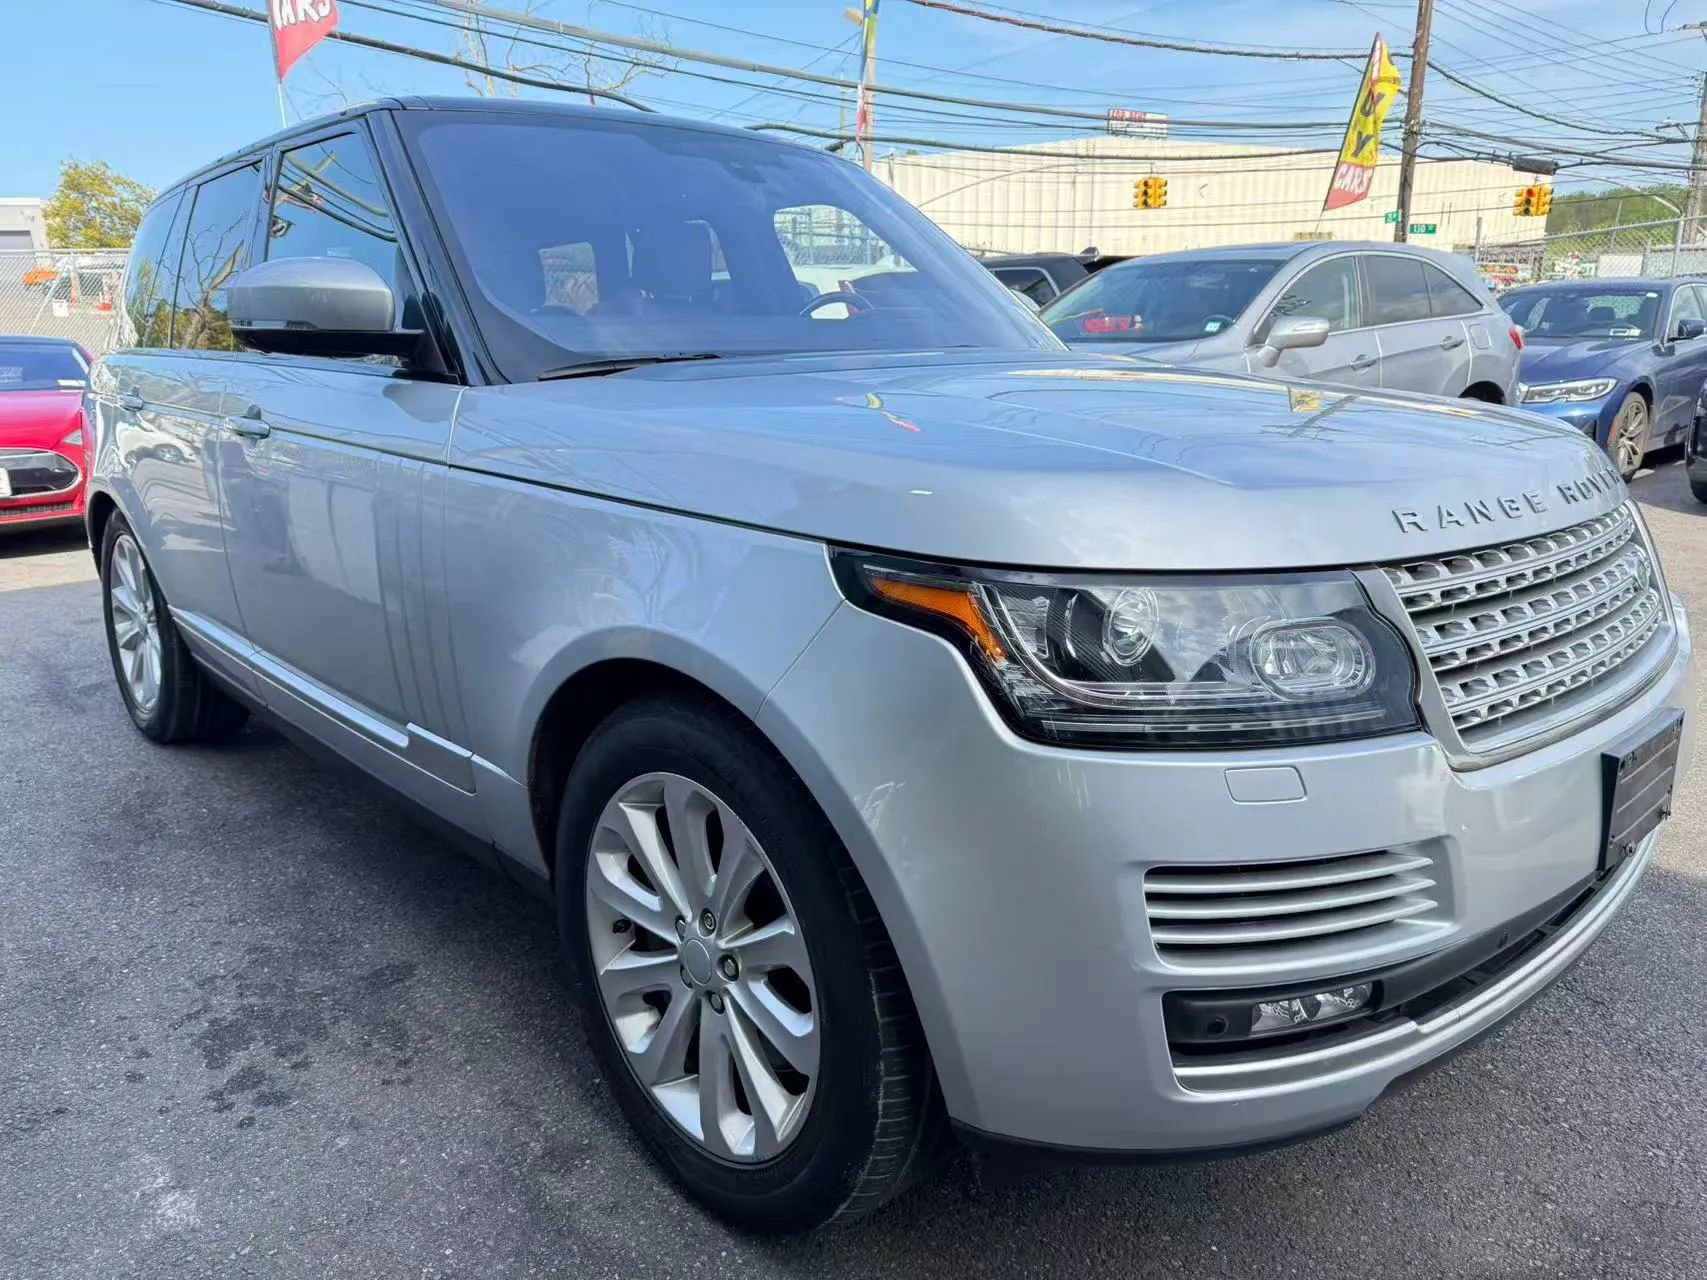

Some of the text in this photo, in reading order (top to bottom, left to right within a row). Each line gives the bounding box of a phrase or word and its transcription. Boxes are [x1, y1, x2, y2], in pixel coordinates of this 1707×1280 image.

[1334, 163, 1375, 195] CARS
[1392, 465, 1620, 533] RANGE ROVER
